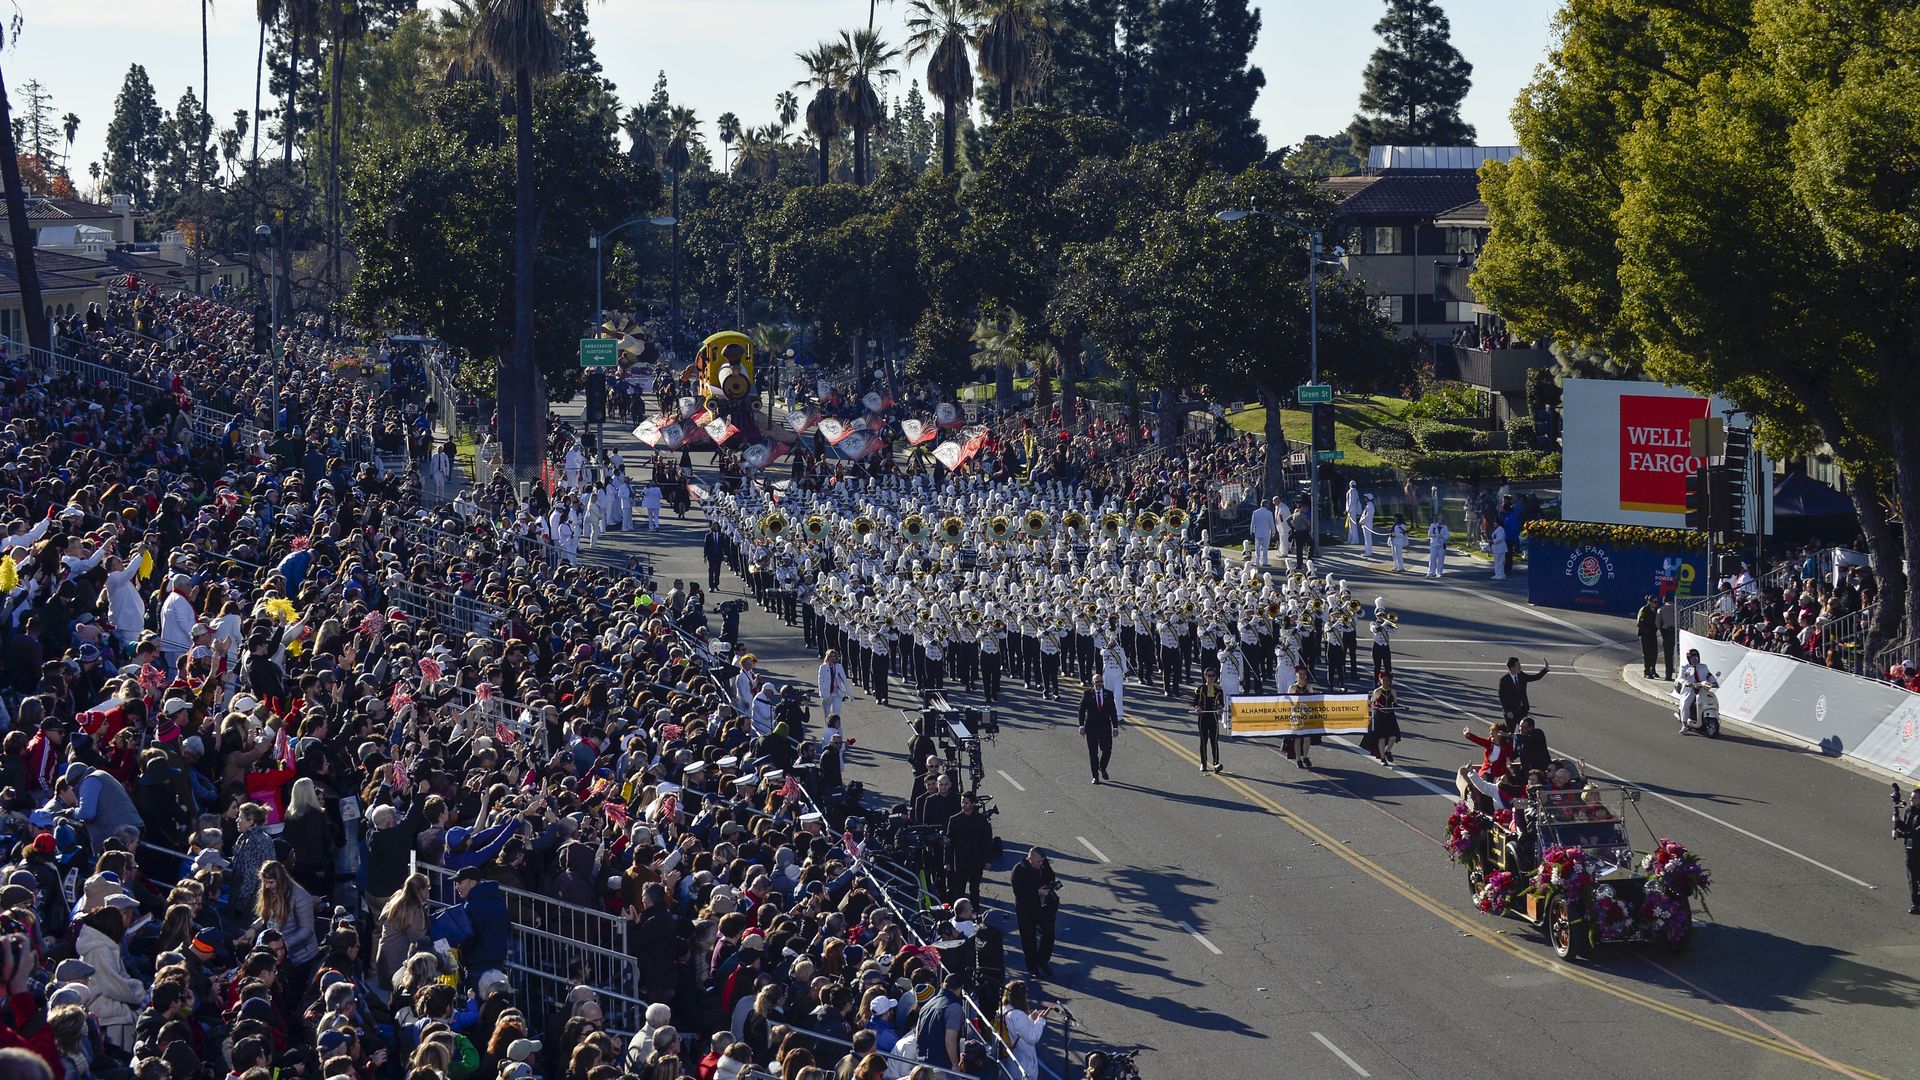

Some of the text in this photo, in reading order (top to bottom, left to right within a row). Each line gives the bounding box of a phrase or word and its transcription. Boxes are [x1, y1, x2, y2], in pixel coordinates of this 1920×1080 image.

[1627, 426, 1691, 448] WELL
[1629, 452, 1701, 474] FARGO
[1565, 545, 1615, 580] ROSE PARADE
